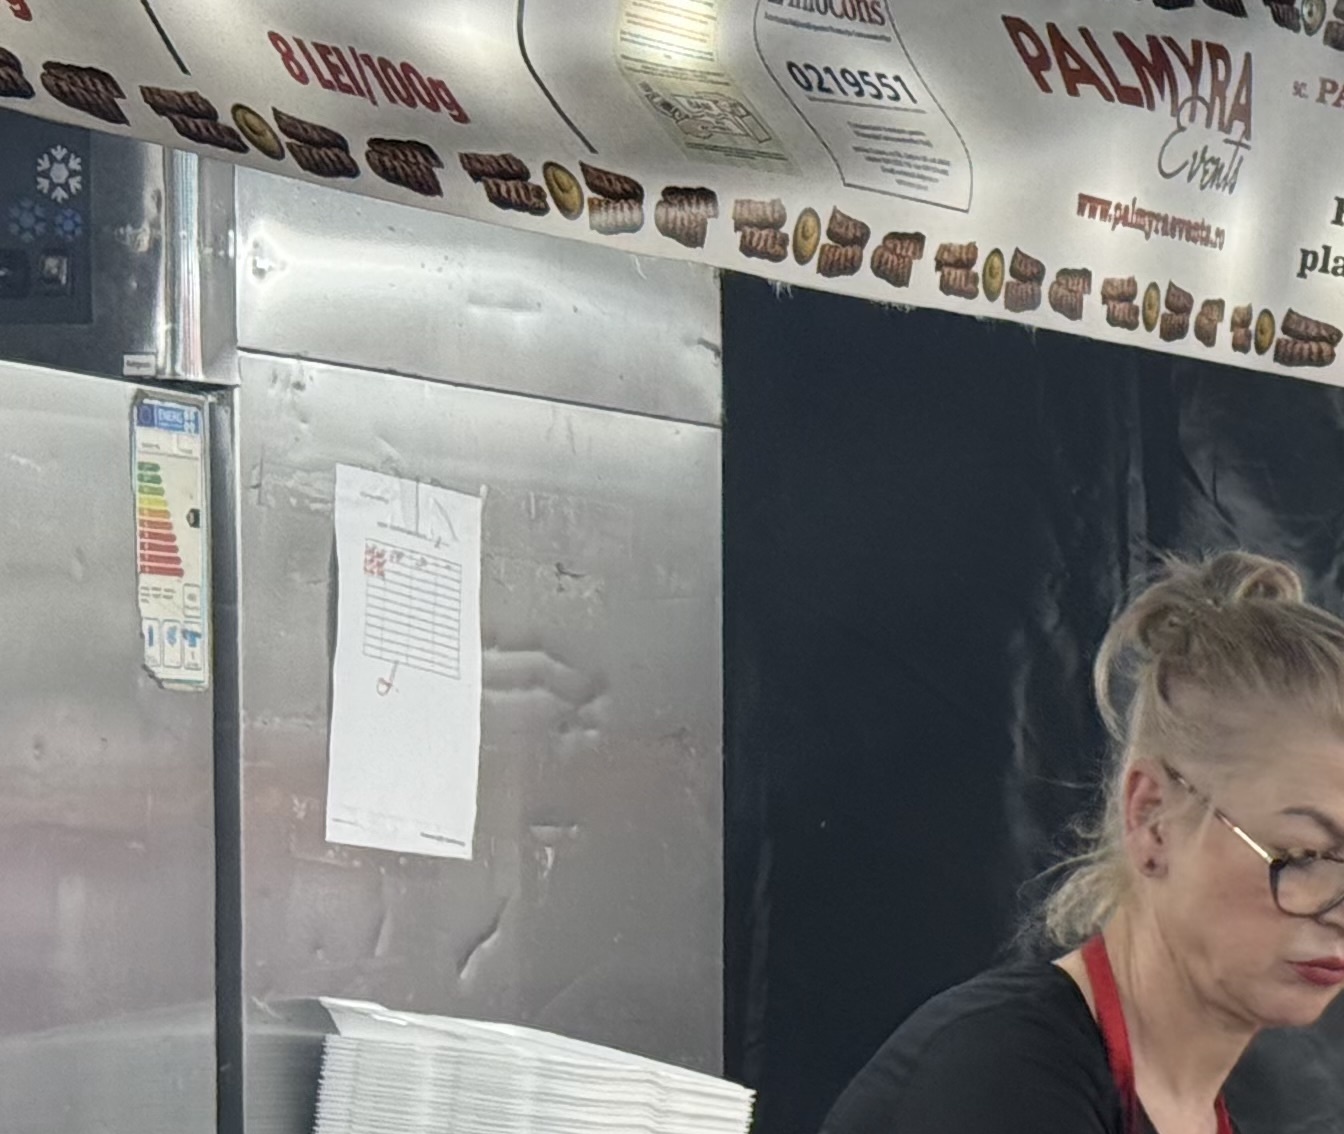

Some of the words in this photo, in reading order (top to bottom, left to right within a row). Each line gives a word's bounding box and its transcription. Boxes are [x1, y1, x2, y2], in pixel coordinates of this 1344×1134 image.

[267, 31, 309, 85] 8
[292, 36, 471, 124] LEI/100g
[786, 61, 917, 104] 0219551
[1001, 15, 1252, 141] PALMYRA
[1158, 95, 1251, 194] Events
